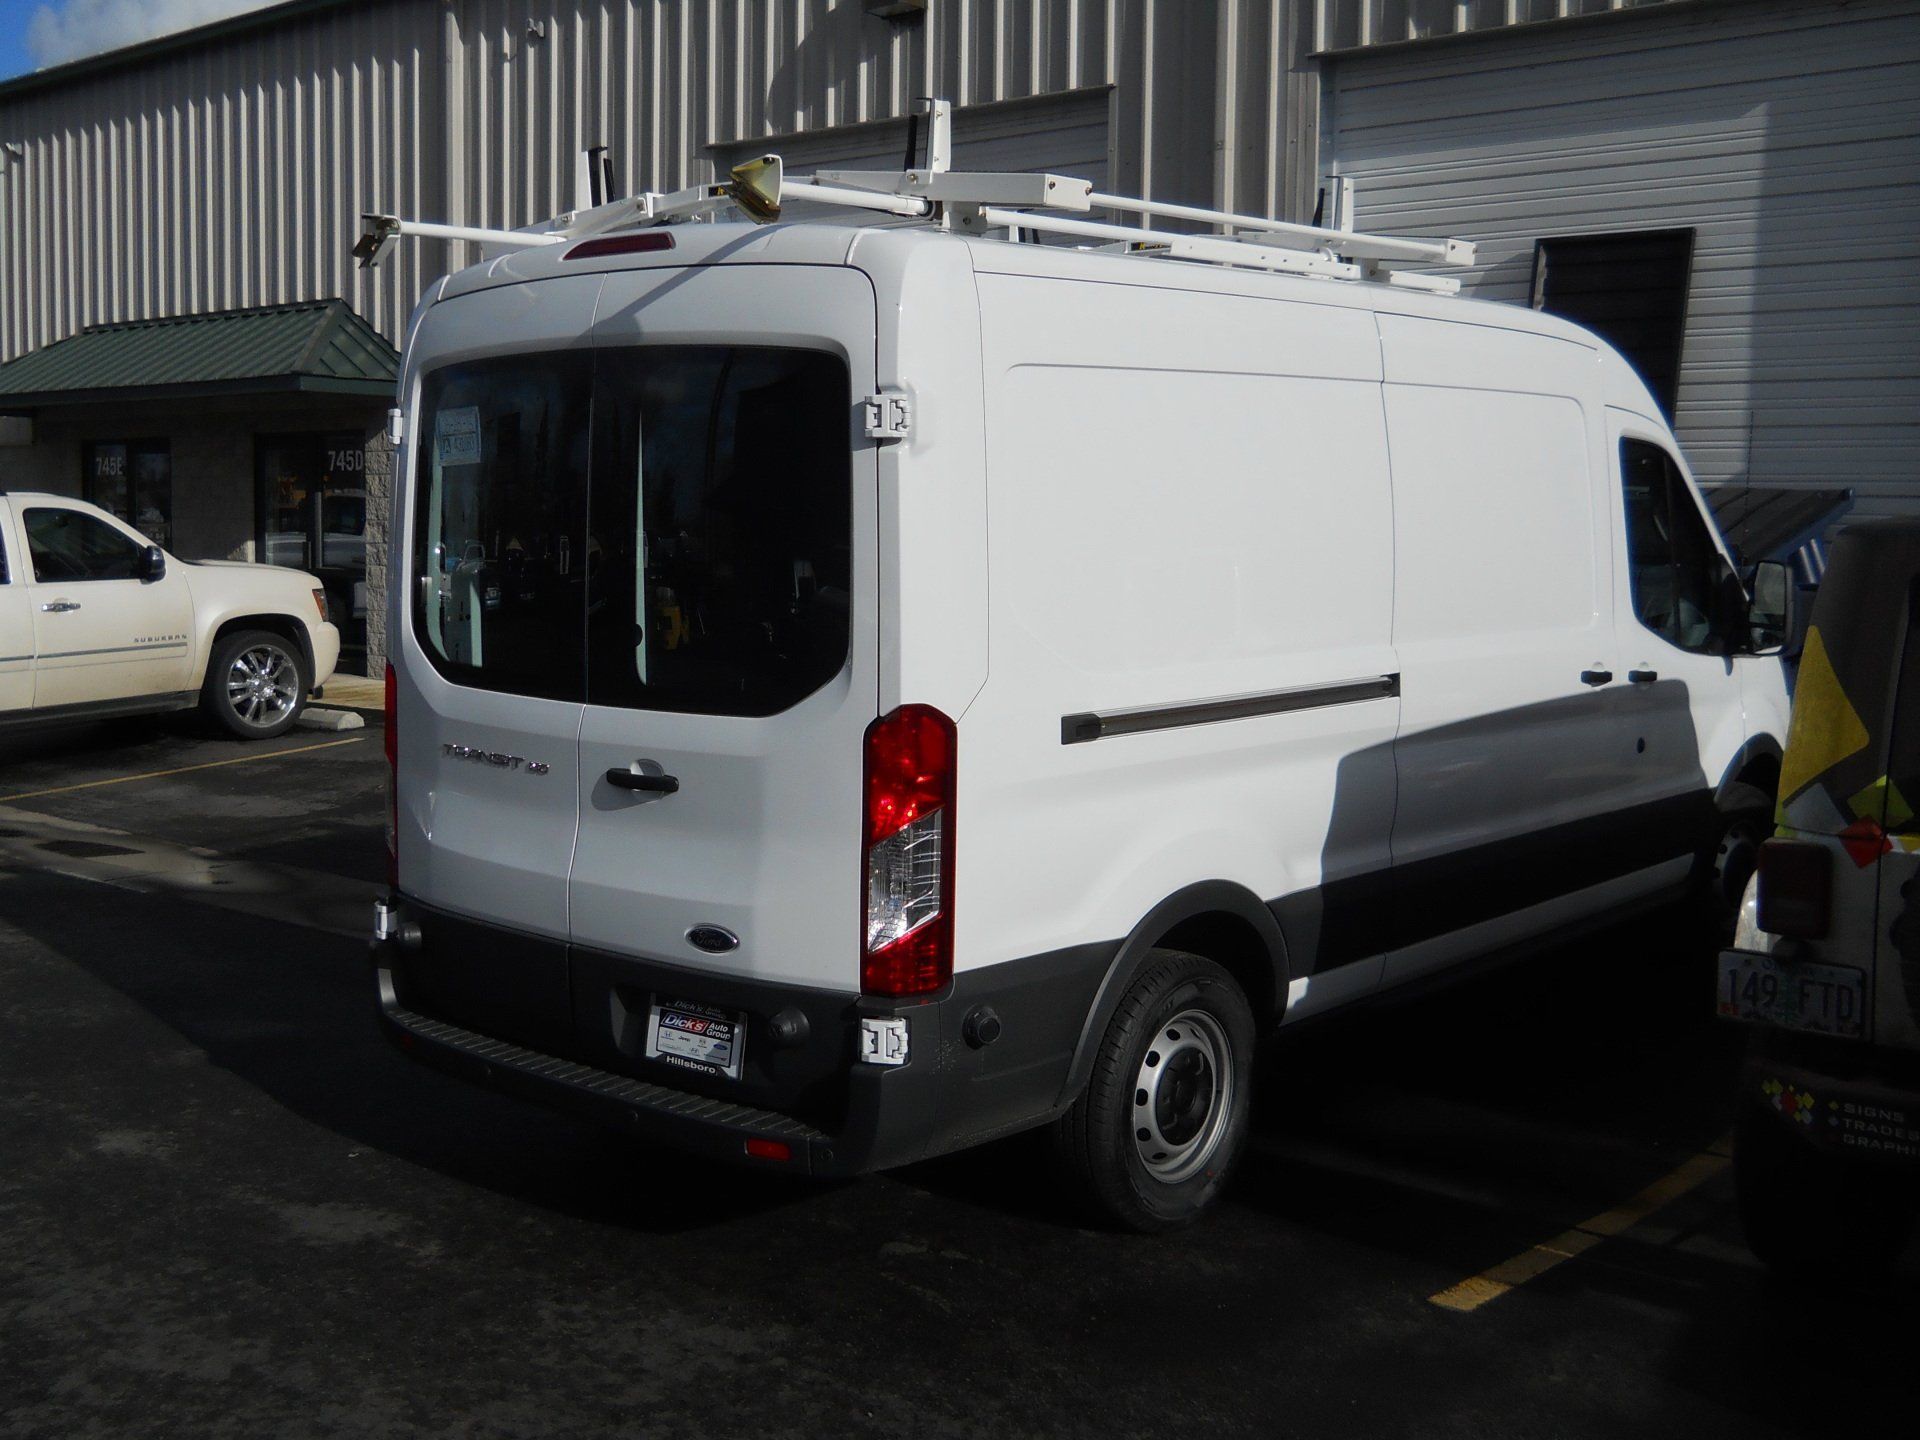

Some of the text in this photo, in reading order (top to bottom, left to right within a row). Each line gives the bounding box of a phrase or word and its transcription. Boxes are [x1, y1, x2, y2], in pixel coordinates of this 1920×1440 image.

[95, 456, 123, 476] 745E
[327, 450, 364, 472] 745D
[134, 633, 187, 643] SUBURBAN
[1727, 967, 1778, 1009] 149
[1798, 978, 1854, 1021] FTD
[706, 1028, 731, 1041] Group
[708, 1022, 729, 1033] Auto
[666, 1055, 716, 1074] Hillsboro
[1842, 1102, 1906, 1123] SIGNS
[1842, 1133, 1920, 1156] GRAPHI
